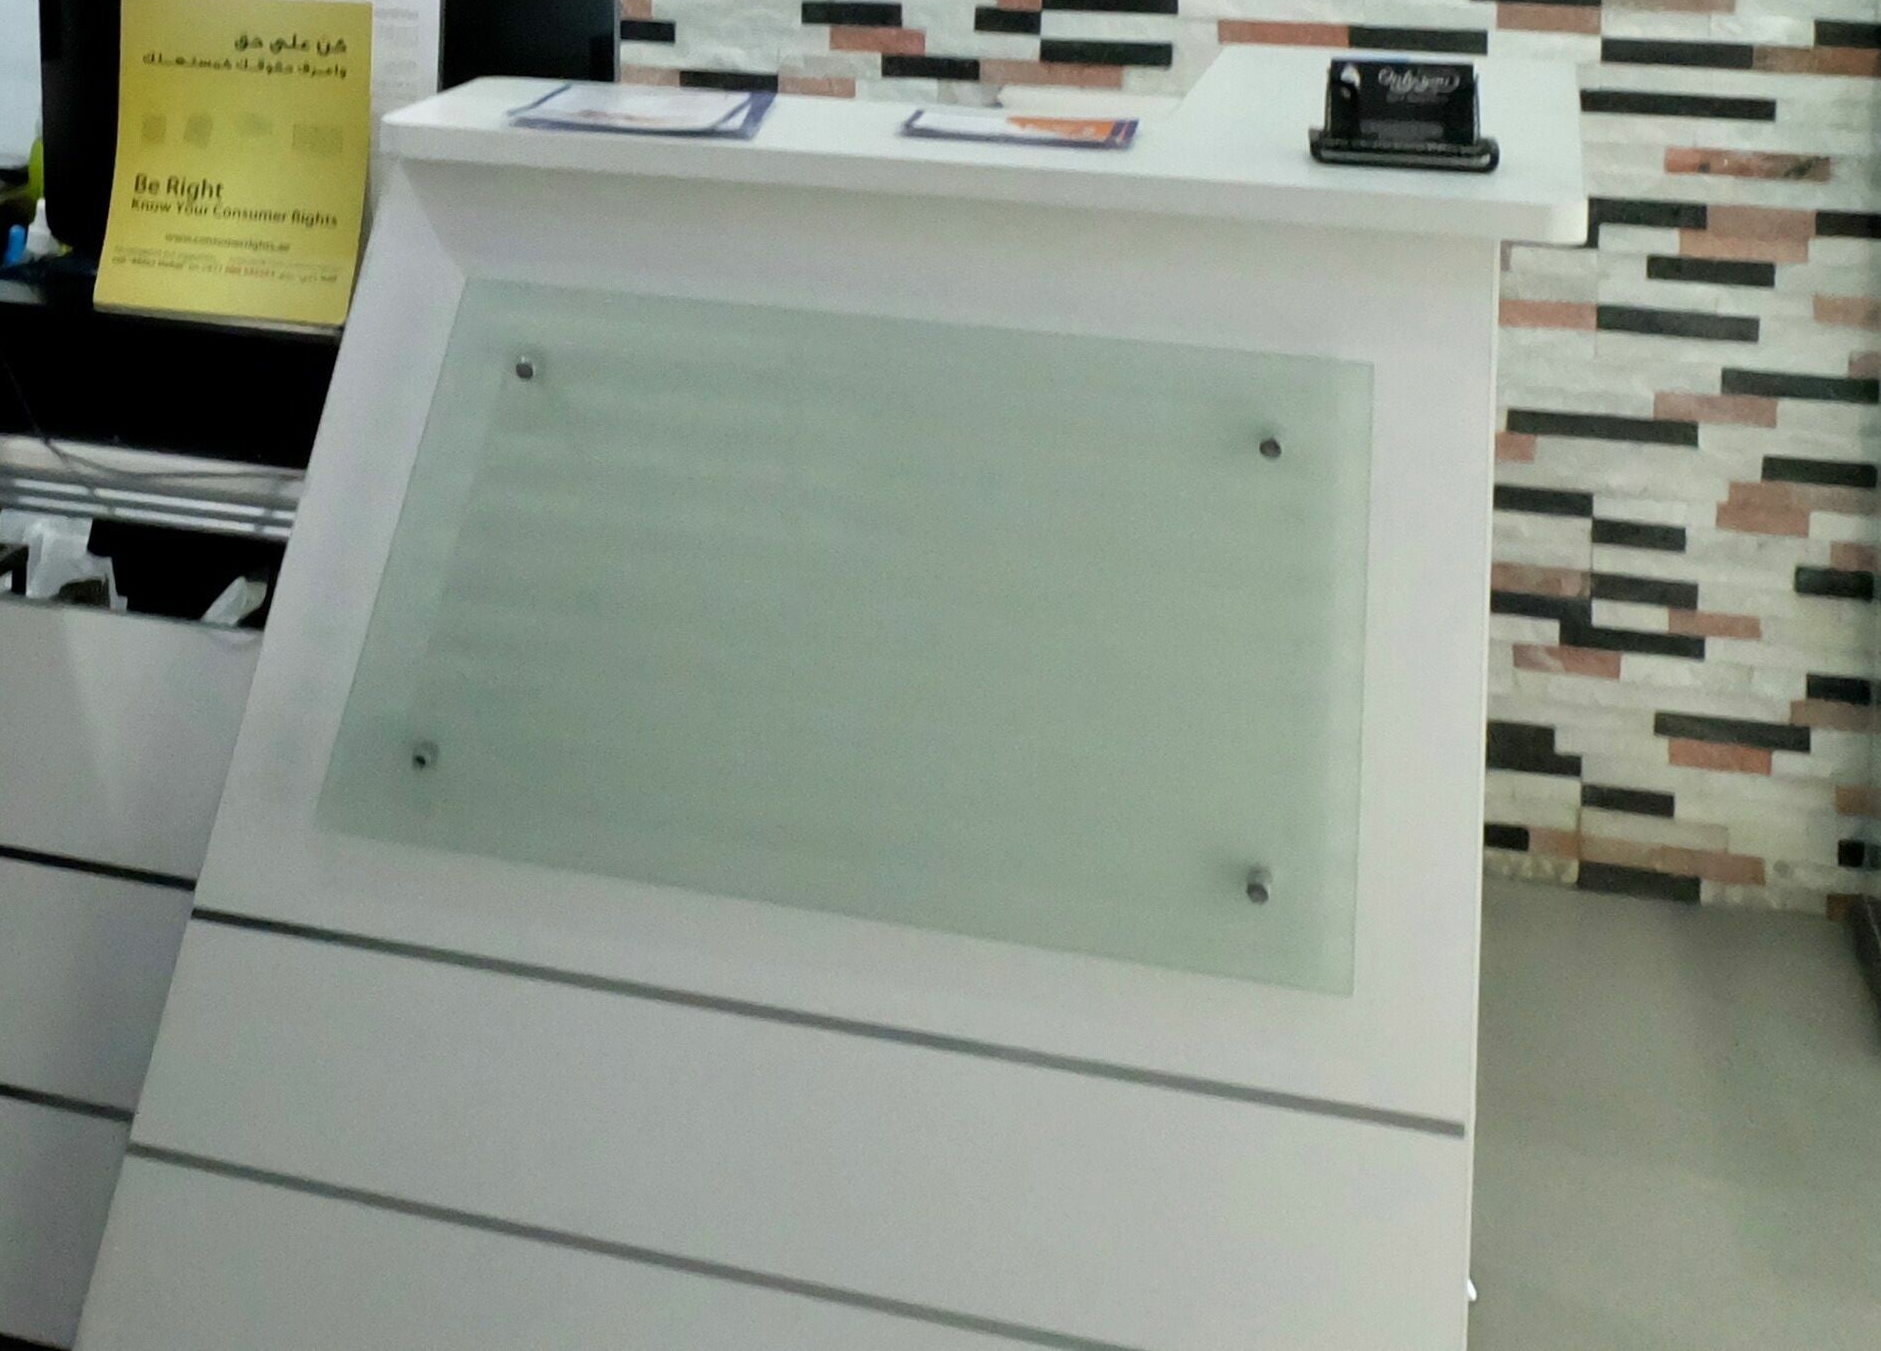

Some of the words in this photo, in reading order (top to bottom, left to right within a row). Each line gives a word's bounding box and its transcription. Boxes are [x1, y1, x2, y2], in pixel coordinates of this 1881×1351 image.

[134, 172, 160, 195] Be
[166, 175, 224, 207] Right
[131, 197, 172, 214] Know
[177, 201, 208, 217] Your
[213, 203, 286, 222] Consumer
[291, 208, 338, 228] Rights
